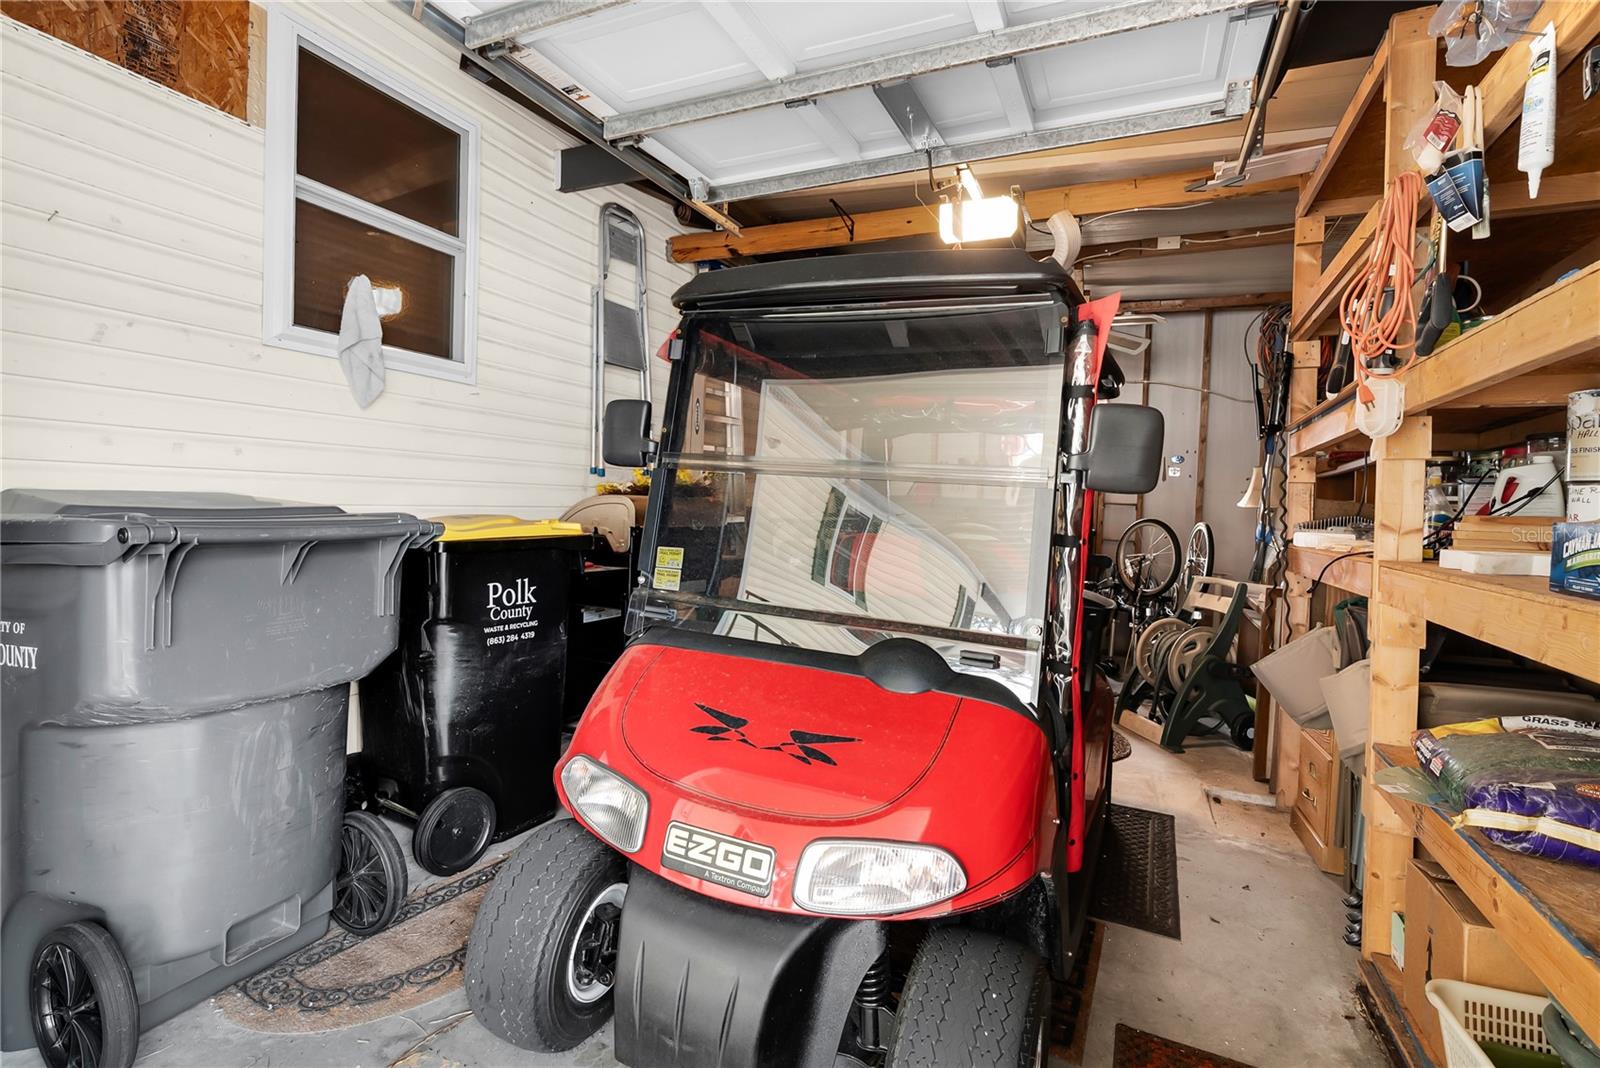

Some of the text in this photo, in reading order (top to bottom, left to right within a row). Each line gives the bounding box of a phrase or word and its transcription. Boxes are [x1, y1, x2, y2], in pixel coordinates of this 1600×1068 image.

[486, 577, 537, 609] Polk
[490, 605, 533, 621] County
[13, 622, 26, 634] OF
[483, 625, 504, 634] WASTE
[509, 620, 539, 631] RECYCLING
[486, 631, 535, 647] (863) 284 4319
[1522, 715, 1569, 727] GRASS
[711, 872, 736, 888] Textron
[736, 880, 769, 896] Company
